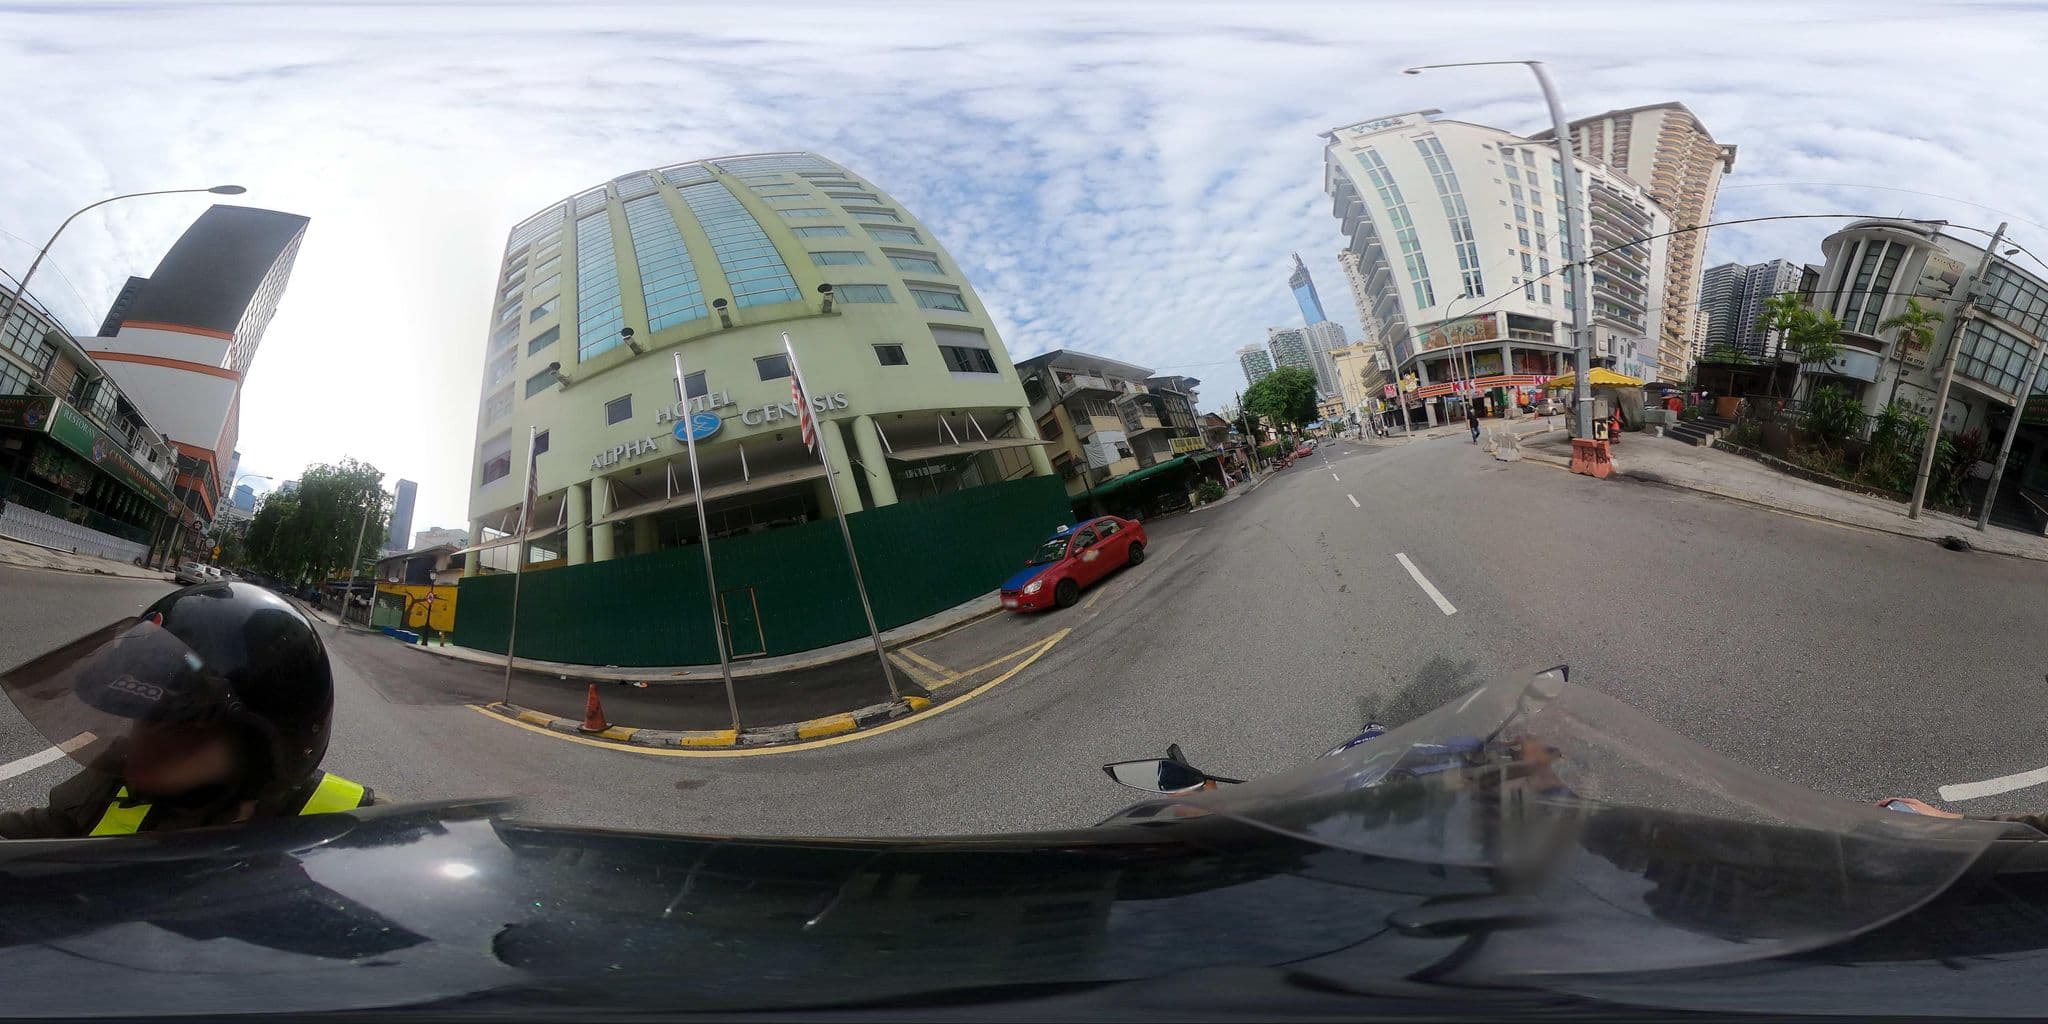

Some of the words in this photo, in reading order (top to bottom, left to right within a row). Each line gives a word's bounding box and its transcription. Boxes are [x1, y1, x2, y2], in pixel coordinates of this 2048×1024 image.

[590, 436, 658, 470] ALPHA
[742, 392, 850, 426] GENSIS
[655, 387, 736, 424] HOTEL
